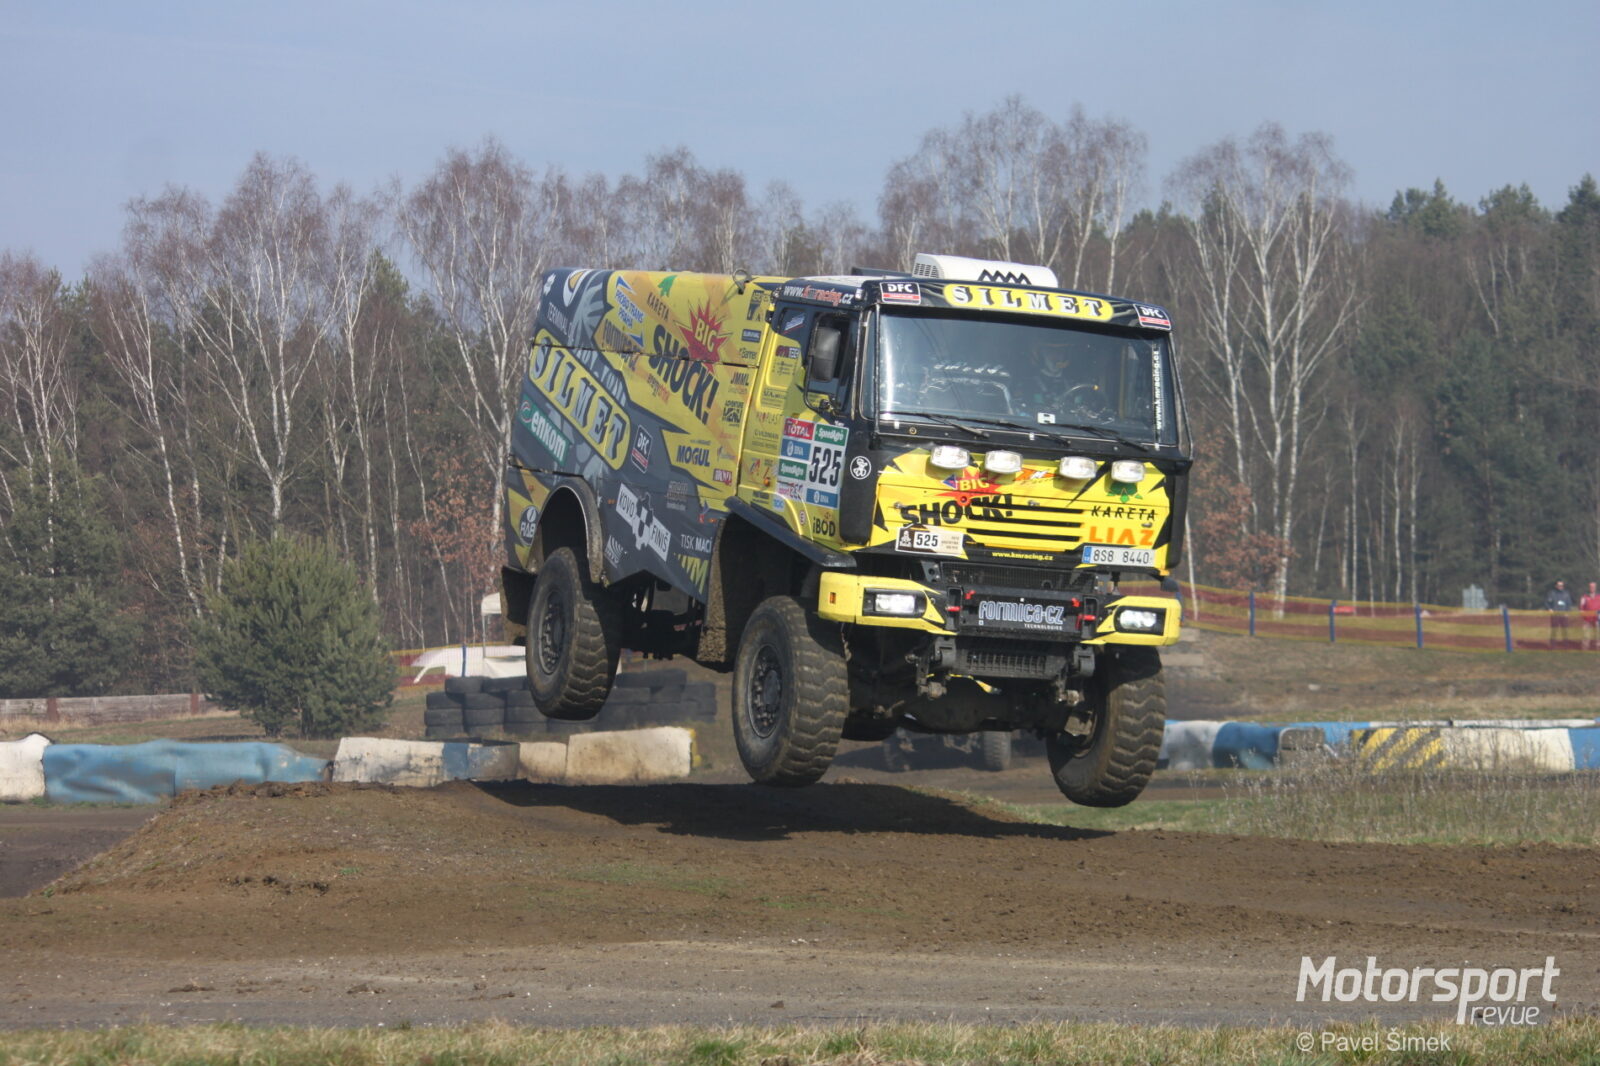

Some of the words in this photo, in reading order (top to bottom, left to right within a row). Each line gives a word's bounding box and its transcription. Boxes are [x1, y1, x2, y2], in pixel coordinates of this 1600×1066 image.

[887, 283, 914, 293] DFC
[647, 292, 669, 322] KARETA
[952, 285, 1103, 317] SILMET
[694, 318, 718, 353] BIG
[648, 324, 719, 425] SHOCK!
[530, 336, 627, 461] SILMET
[531, 411, 566, 462] enkom
[787, 423, 811, 437] TOTAL
[676, 445, 710, 467] MOGUL
[809, 446, 842, 487] 525
[959, 478, 990, 491] BIG
[620, 490, 635, 518] KOVO
[900, 493, 1013, 526] SHOCK!
[1091, 505, 1155, 521] KARETA
[681, 534, 694, 549] TISK
[916, 533, 938, 547] 525
[1089, 526, 1154, 546] LIAZ
[992, 550, 1053, 561] www.kmracing.cz
[1093, 549, 1114, 562] 8S8
[1122, 551, 1150, 564] 8440
[1024, 623, 1063, 631] TECHNOLOGIES
